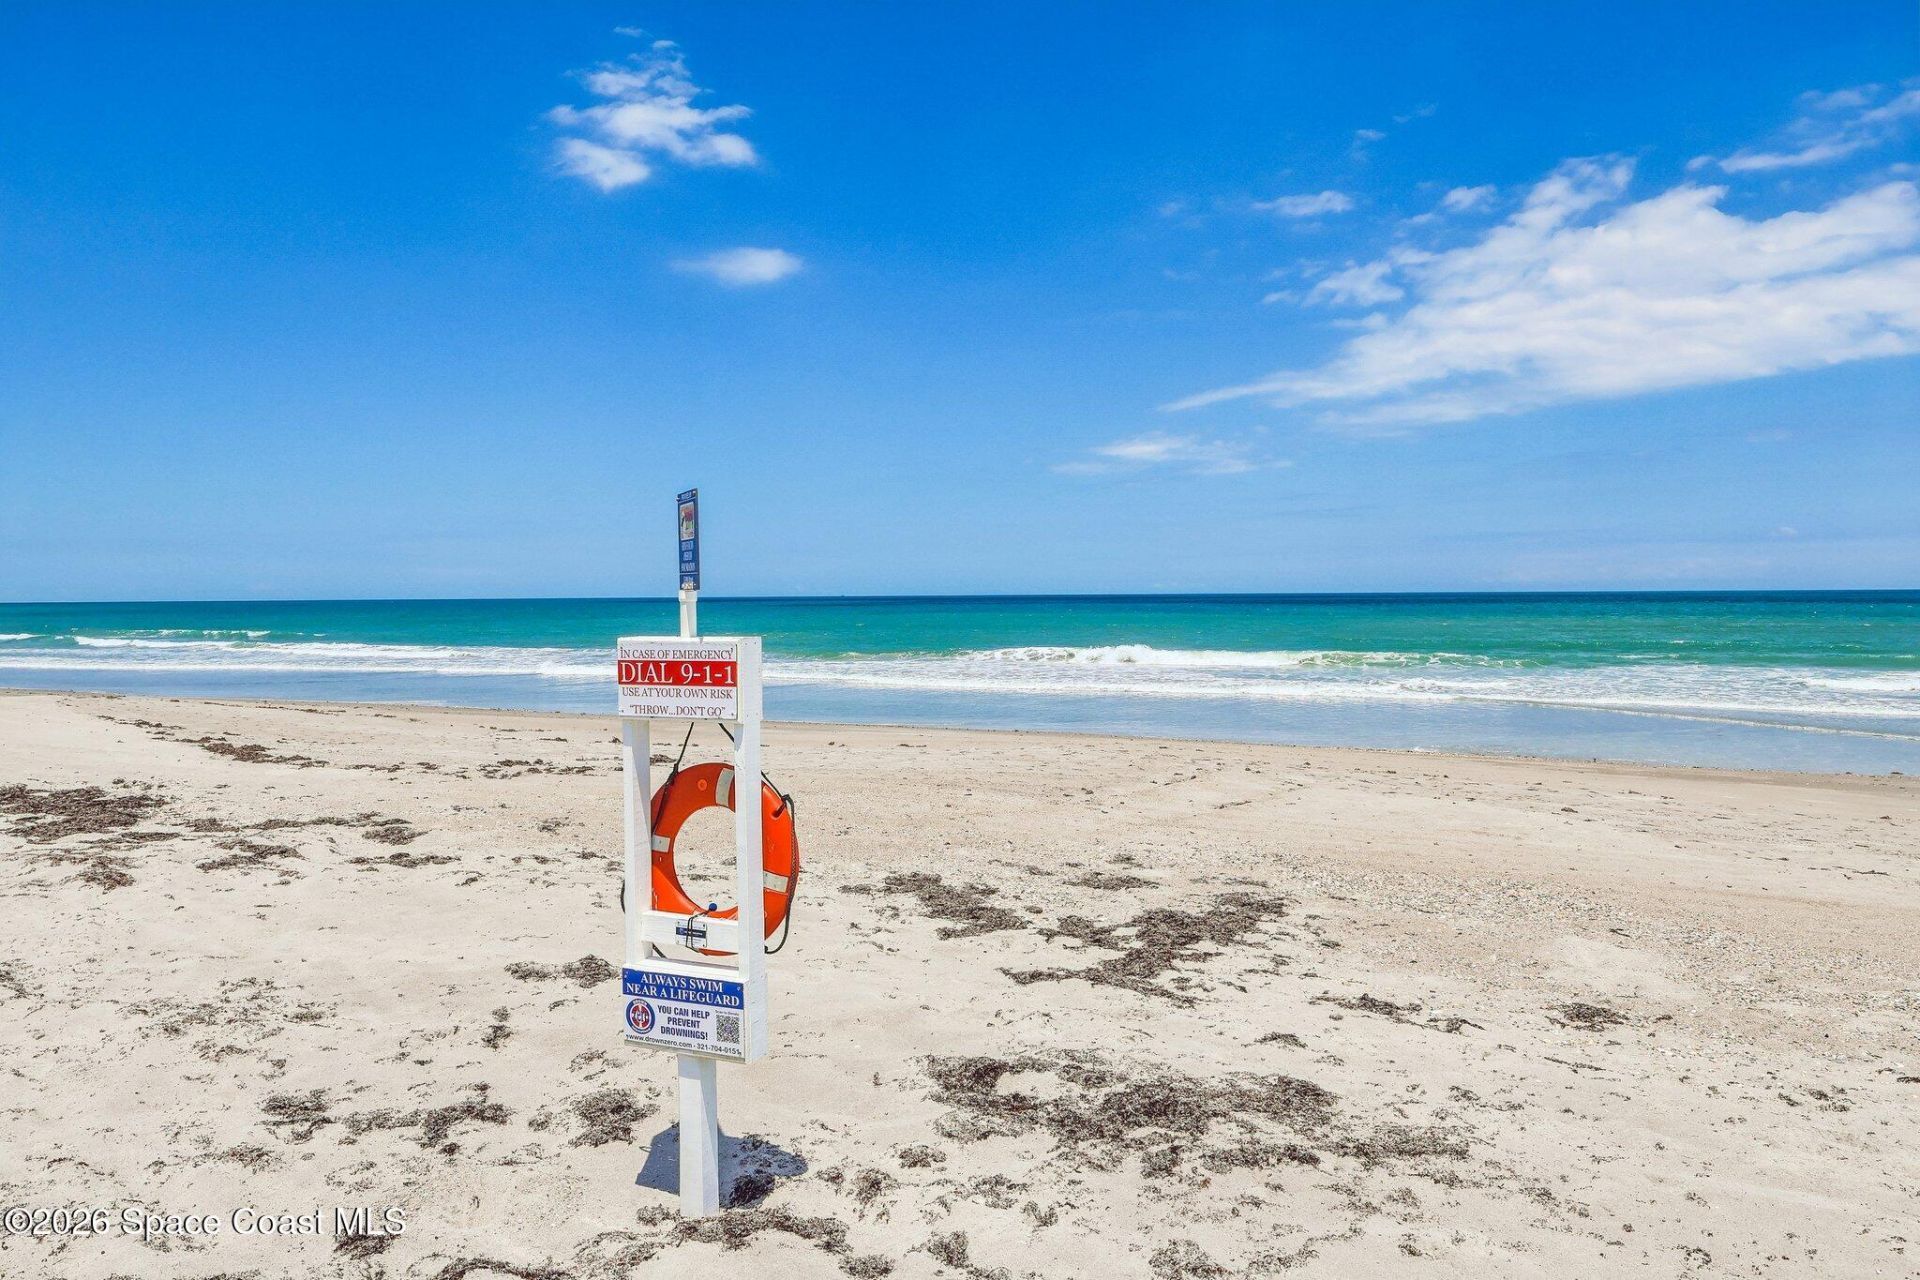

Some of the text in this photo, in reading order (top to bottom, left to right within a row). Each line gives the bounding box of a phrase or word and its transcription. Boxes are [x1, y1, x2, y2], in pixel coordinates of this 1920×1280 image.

[620, 649, 733, 660] IN CASE OF EMERGENCY
[620, 662, 735, 685] DIAL 9-1-1
[622, 687, 733, 700] USE AT YOUR OWN RISK
[640, 973, 723, 993] ALWAYS SWIM
[626, 982, 740, 1007] NEAR A LIFEGUARD
[657, 1005, 672, 1015] YOU
[674, 1007, 689, 1017] CAN
[691, 1009, 710, 1020] HELP
[667, 1016, 701, 1029] PREVENT
[660, 1026, 708, 1041] DROWNINGS!
